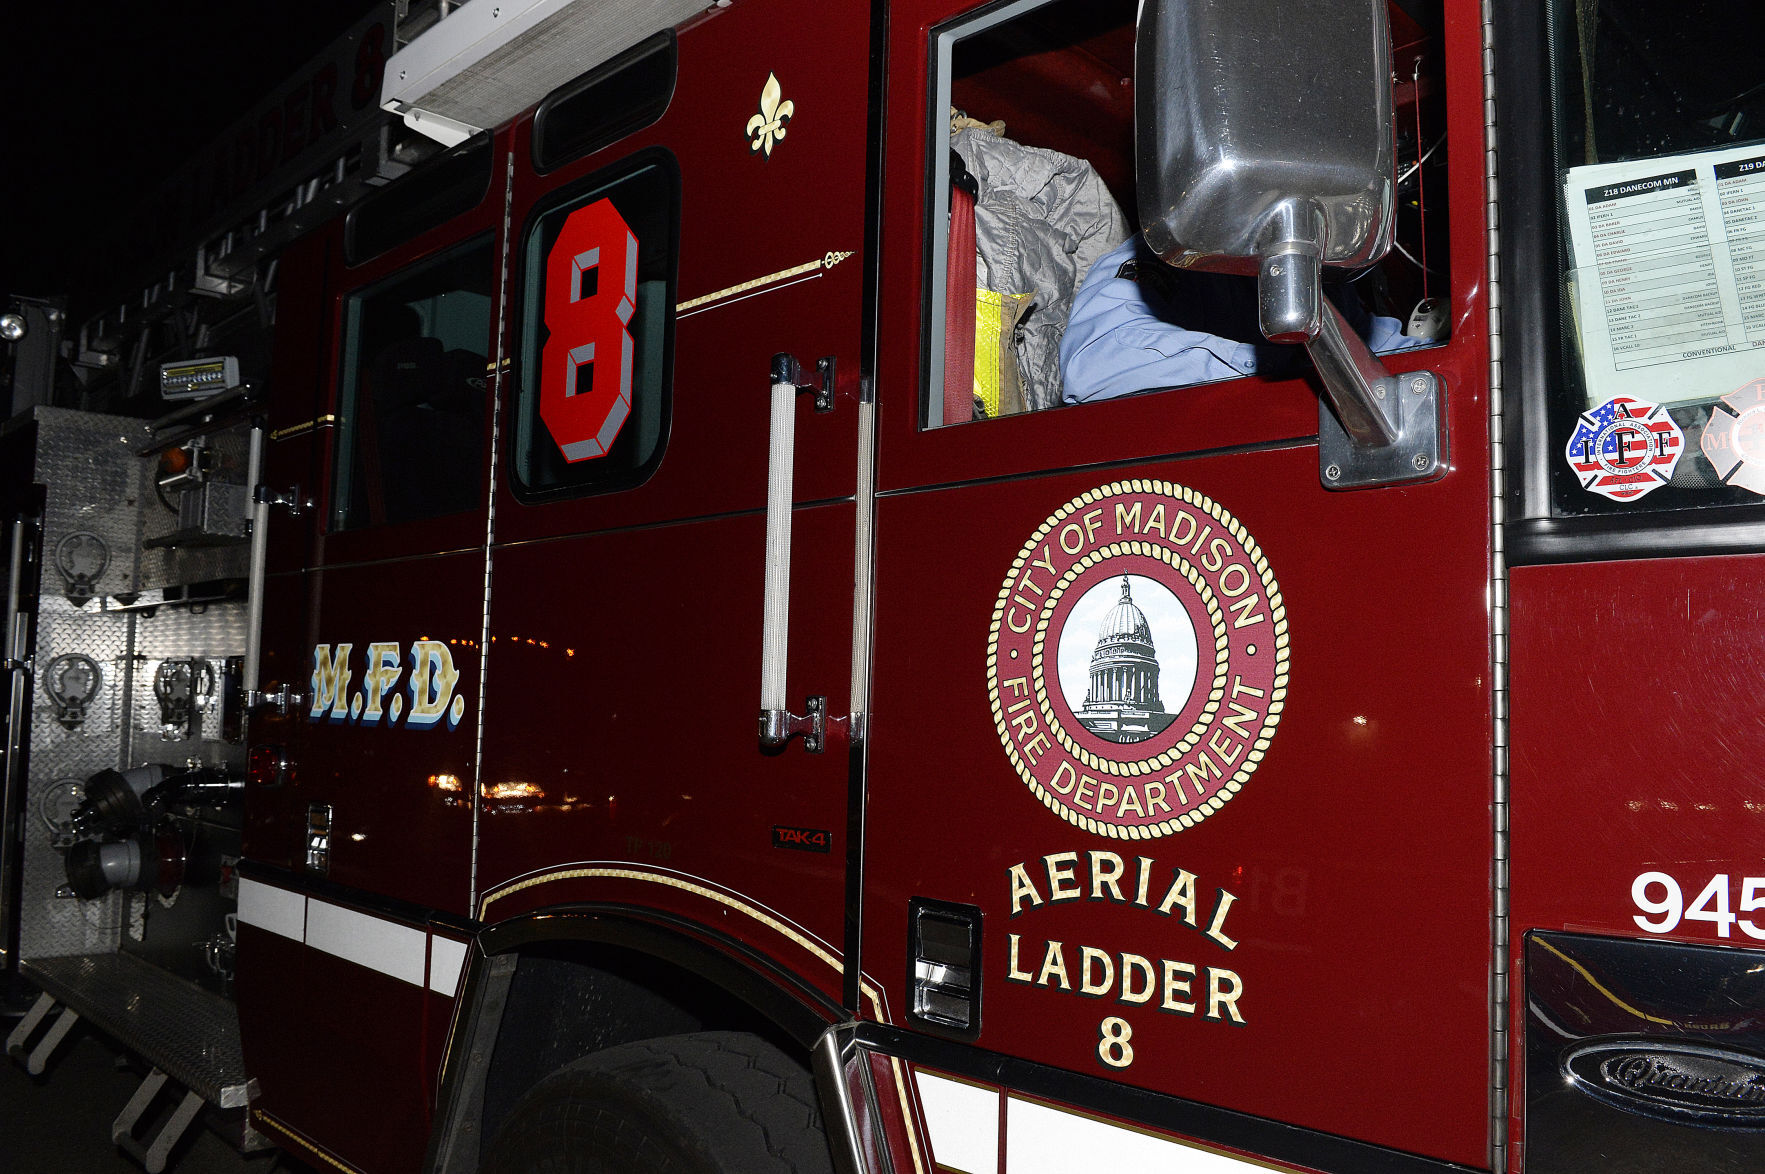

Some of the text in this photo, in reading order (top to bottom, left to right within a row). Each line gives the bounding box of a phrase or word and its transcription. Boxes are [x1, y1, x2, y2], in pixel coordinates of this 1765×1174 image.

[352, 22, 385, 110] 8
[1603, 177, 1679, 197] Z18 DANECOM MN
[1739, 163, 1754, 172] Z19
[539, 197, 640, 464] 8
[1682, 344, 1736, 359] CONVENTIONAL
[1613, 403, 1633, 420] A
[1596, 423, 1654, 456] INTERNATIONAL ASSOCIATION
[1615, 431, 1635, 465] F
[1657, 431, 1671, 457] F
[1705, 432, 1728, 451] M
[1604, 463, 1616, 473] FIRE
[1007, 501, 1265, 634] CITY OF MADISON
[309, 641, 464, 732] M.F.D.
[1003, 675, 1266, 818] FIRE DEPARTMENT
[1005, 850, 1240, 951] AERIAL
[1005, 933, 1248, 1028] LADDER
[1095, 1016, 1134, 1072] 8
